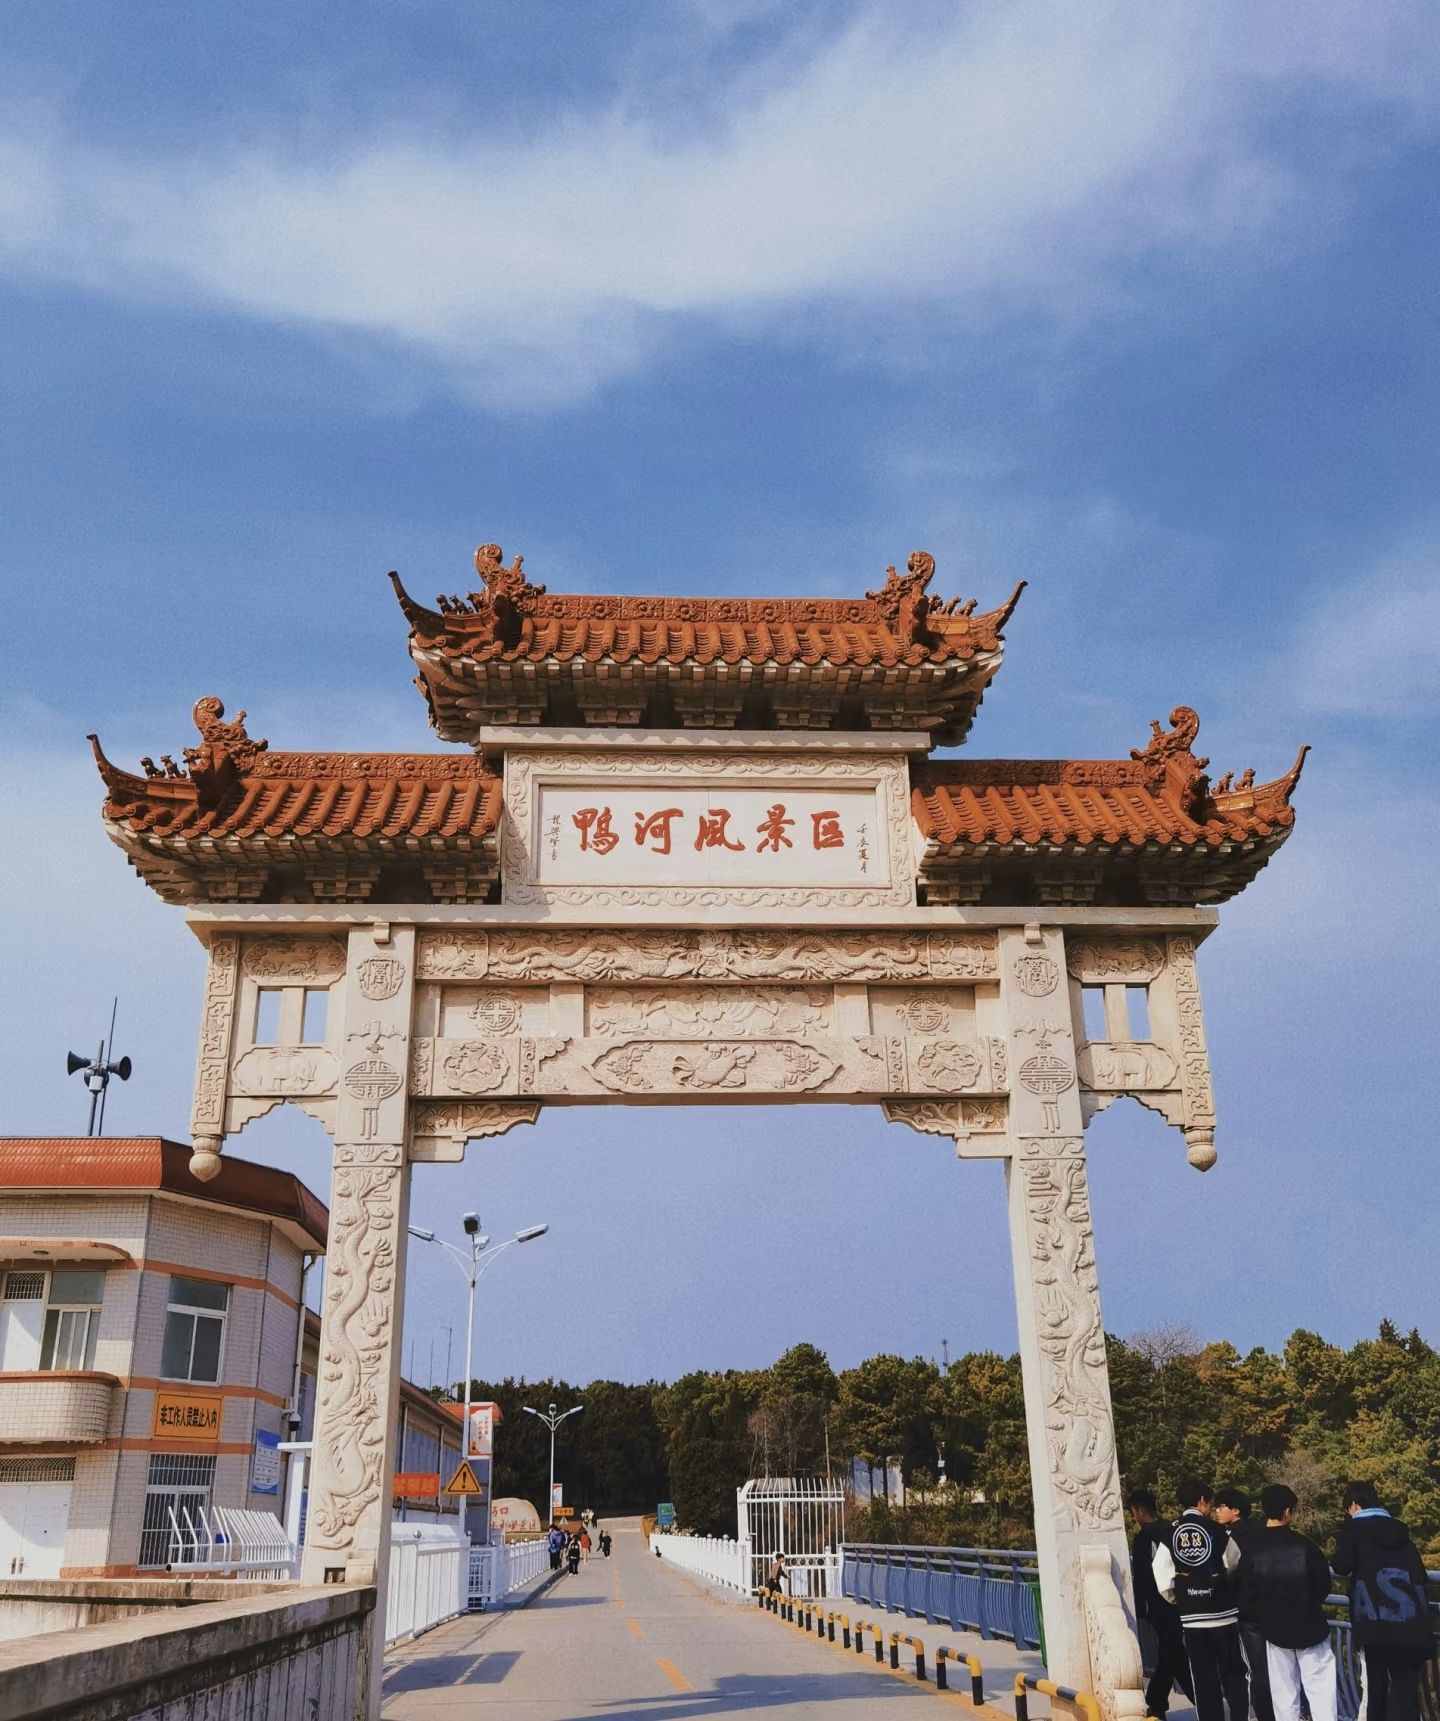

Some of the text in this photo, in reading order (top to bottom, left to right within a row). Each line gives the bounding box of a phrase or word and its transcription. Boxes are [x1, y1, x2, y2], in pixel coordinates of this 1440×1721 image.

[160, 1405, 217, 1429] 非工作人员禁止入内
